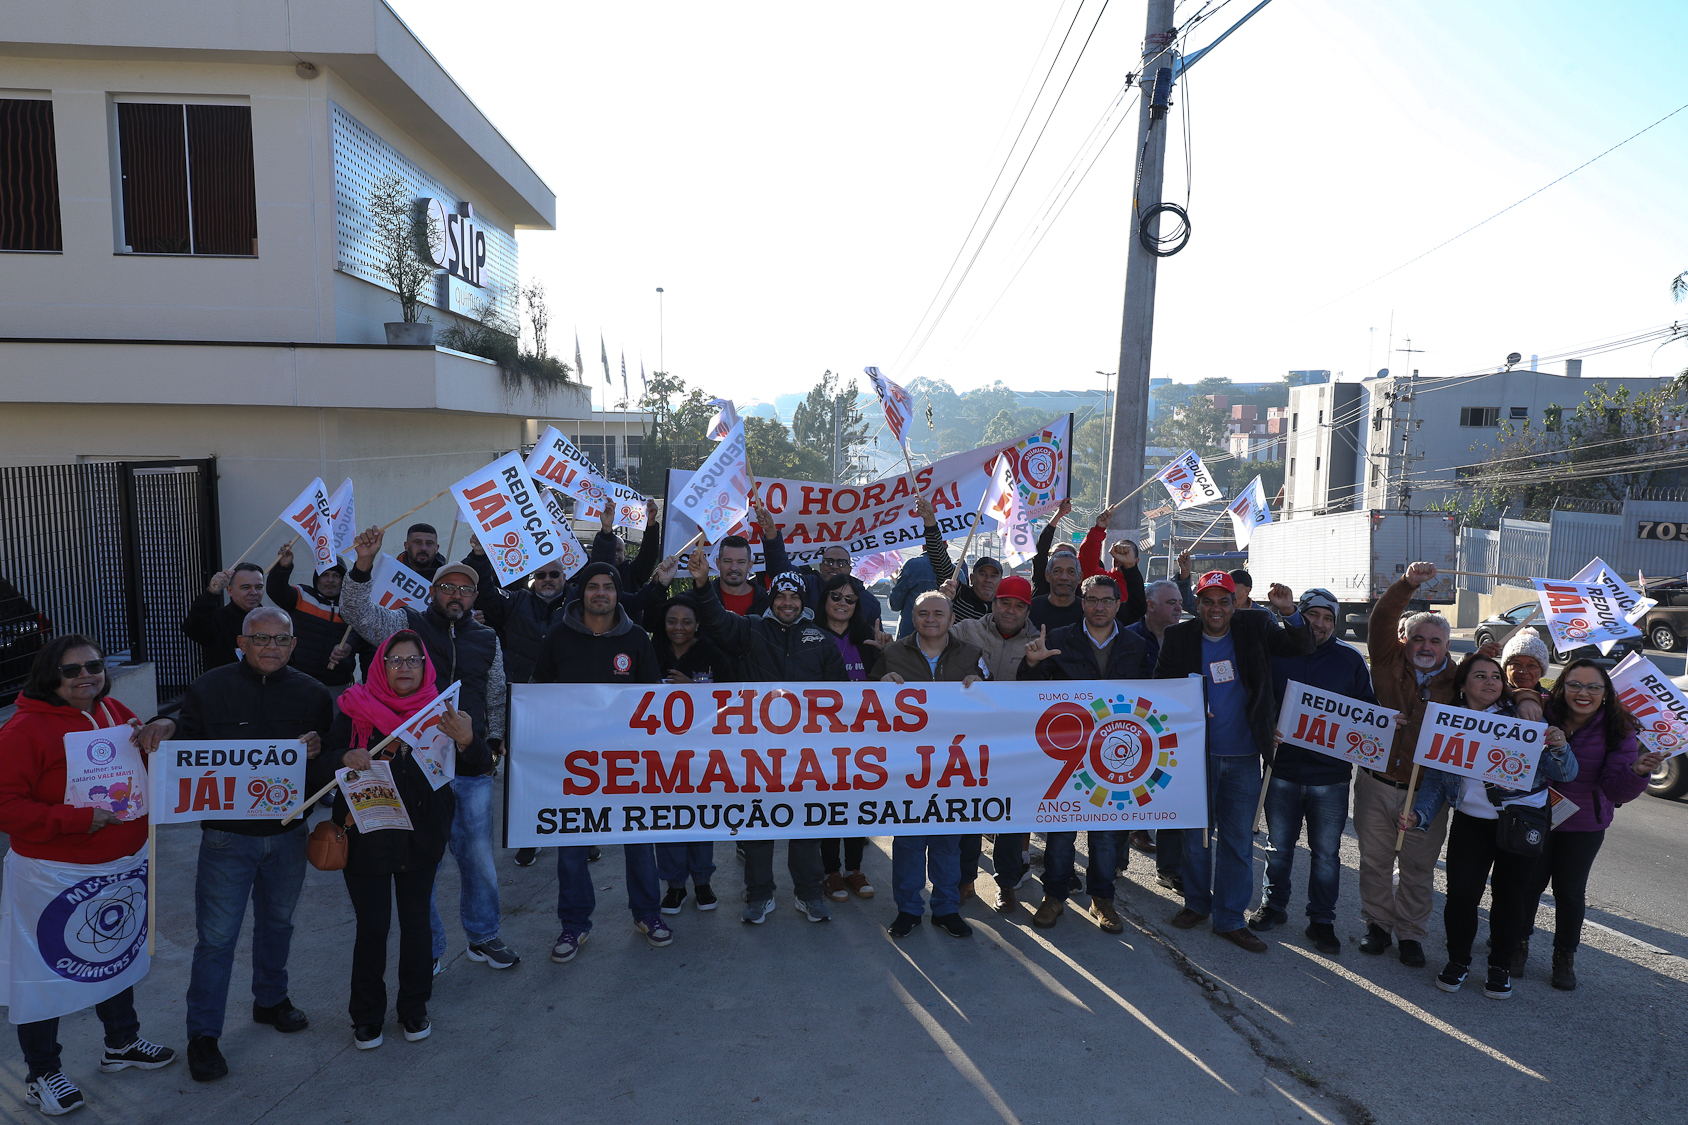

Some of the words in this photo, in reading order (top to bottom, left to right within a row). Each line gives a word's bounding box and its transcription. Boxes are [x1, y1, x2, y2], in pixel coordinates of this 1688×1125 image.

[536, 455, 578, 488] JÁ!
[1184, 455, 1215, 497] REDUÇÃO
[462, 479, 513, 533] JÁ!
[799, 467, 933, 515] HORAS
[501, 465, 554, 557] REDUÇÃO
[850, 534, 879, 552] DE
[885, 512, 985, 546] SALRIO!
[1640, 521, 1688, 541] 705
[1542, 583, 1589, 614] JÁ!
[629, 690, 694, 735] 40
[712, 689, 928, 734] HORAS
[1038, 693, 1070, 701] RUMO
[1073, 692, 1094, 701] AOS
[1301, 692, 1390, 729] REDUÇÃO
[1640, 674, 1688, 726] REDUÇ
[1100, 721, 1143, 738] QUÍMICOS
[1292, 713, 1340, 749] JÁ!
[1435, 711, 1538, 743] REDUÇÃO
[177, 745, 298, 770] REDUÇÃO
[563, 746, 888, 795] SEMANAIS
[906, 735, 989, 789] JÁ!
[1424, 732, 1481, 770] JÁ!
[72, 775, 96, 783] salário
[97, 772, 115, 780] VALE
[83, 766, 110, 774] Mulher:
[1107, 771, 1134, 783] ABC
[174, 770, 237, 814] JÁ!
[1037, 801, 1081, 813] ANOS
[536, 807, 612, 834] SEM
[622, 799, 794, 835] REDUÇÃO
[804, 802, 848, 827] DE
[857, 794, 1011, 825] SALÁRIO!
[1035, 814, 1117, 823] CONSTRUINDO
[1121, 813, 1130, 822] O
[1132, 812, 1177, 821] FUTURO
[56, 953, 130, 978] QUÍMICAS
